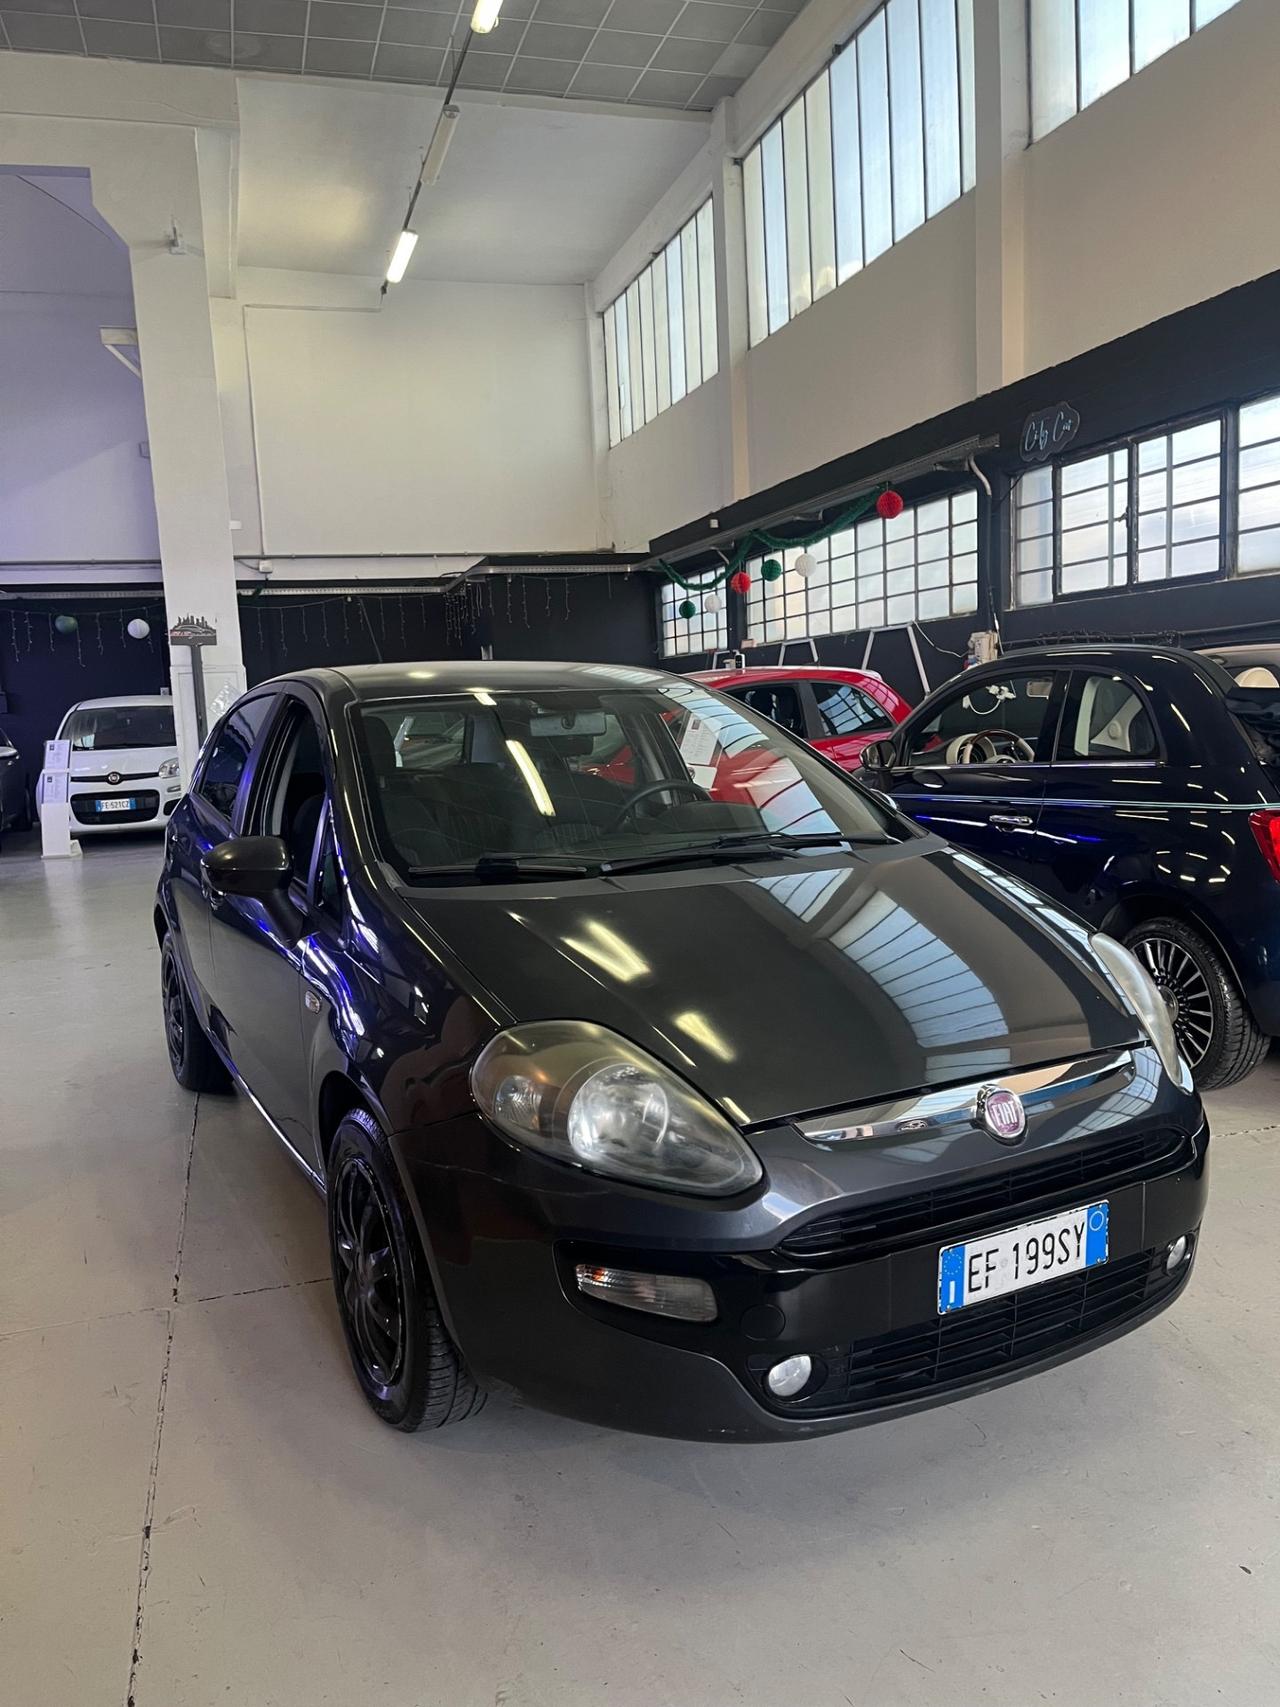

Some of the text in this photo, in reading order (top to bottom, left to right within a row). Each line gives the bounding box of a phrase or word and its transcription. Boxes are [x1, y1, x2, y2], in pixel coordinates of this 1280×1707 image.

[991, 1100, 1018, 1127] FIAT
[968, 1221, 1086, 1293] EF 199SY
[949, 1280, 956, 1304] I
